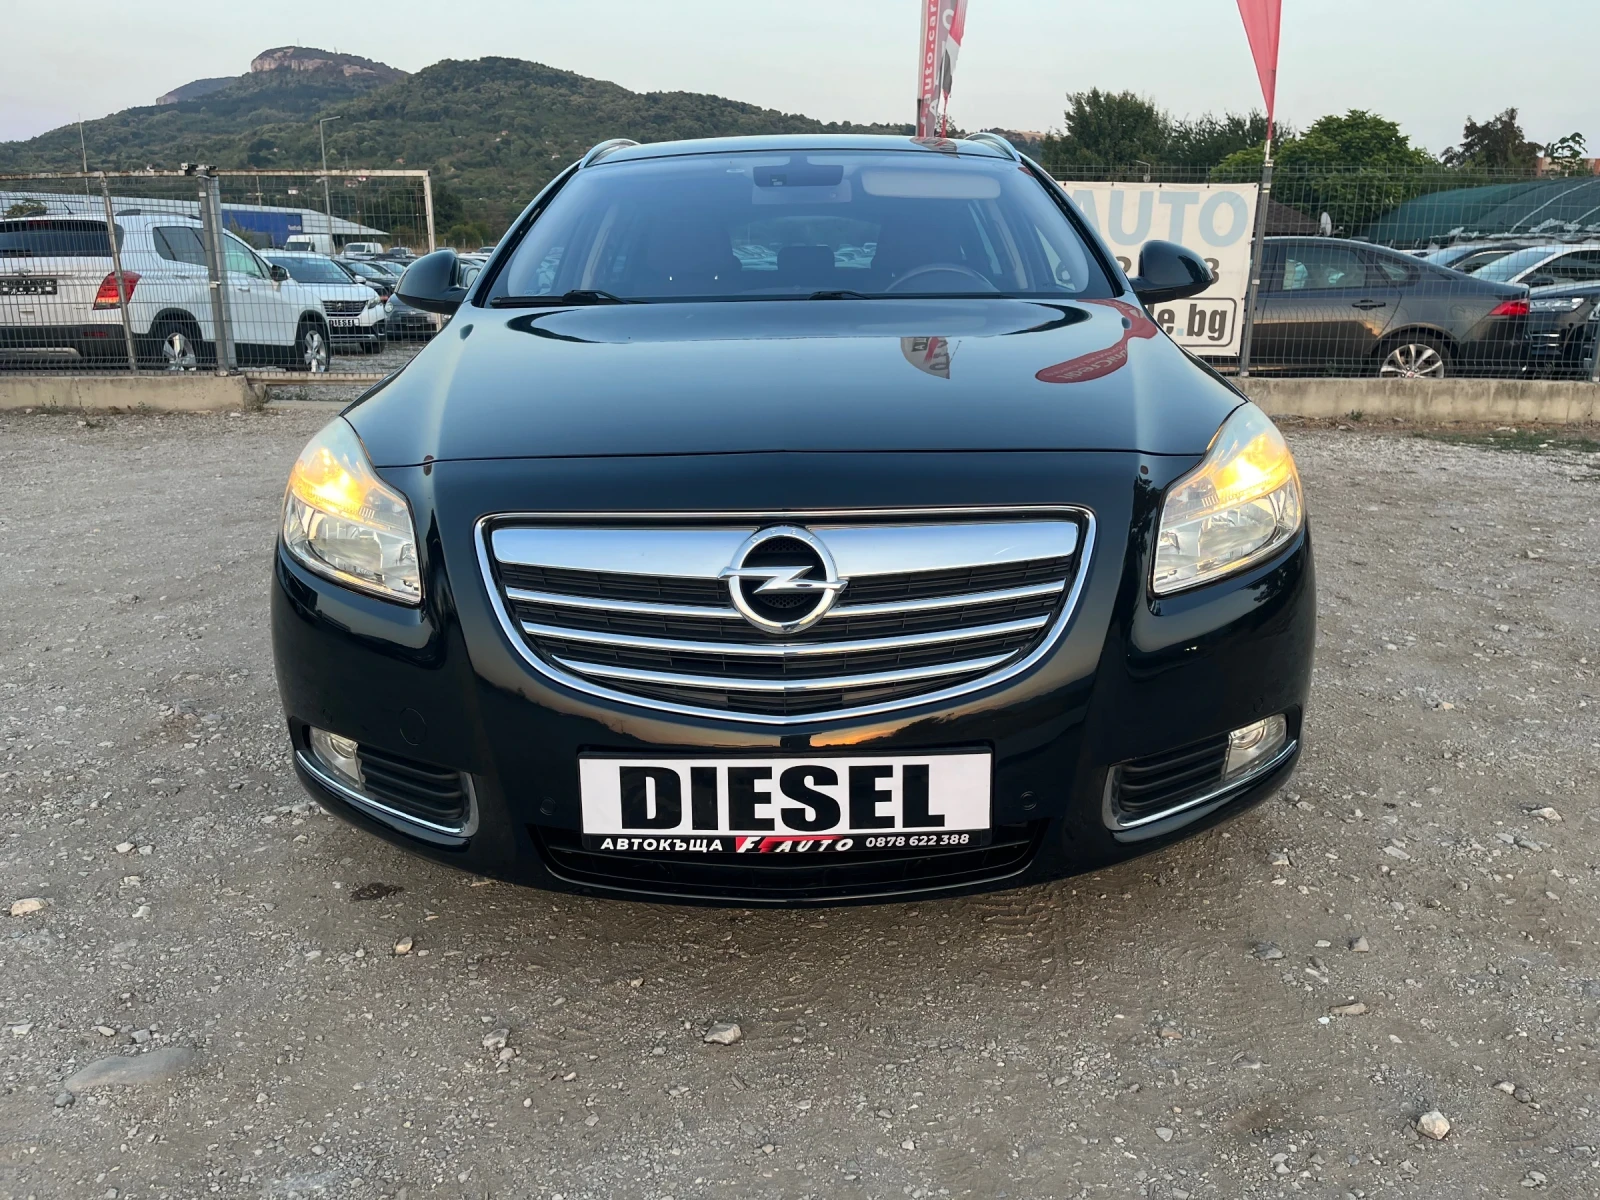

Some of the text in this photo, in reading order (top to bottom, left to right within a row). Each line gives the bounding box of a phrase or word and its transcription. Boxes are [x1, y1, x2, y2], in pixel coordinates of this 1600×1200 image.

[619, 763, 945, 832] DIESEL
[601, 838, 723, 853] АВТОКЪЩА
[774, 838, 854, 853] AUTO
[865, 833, 970, 848] 0878 622 388
